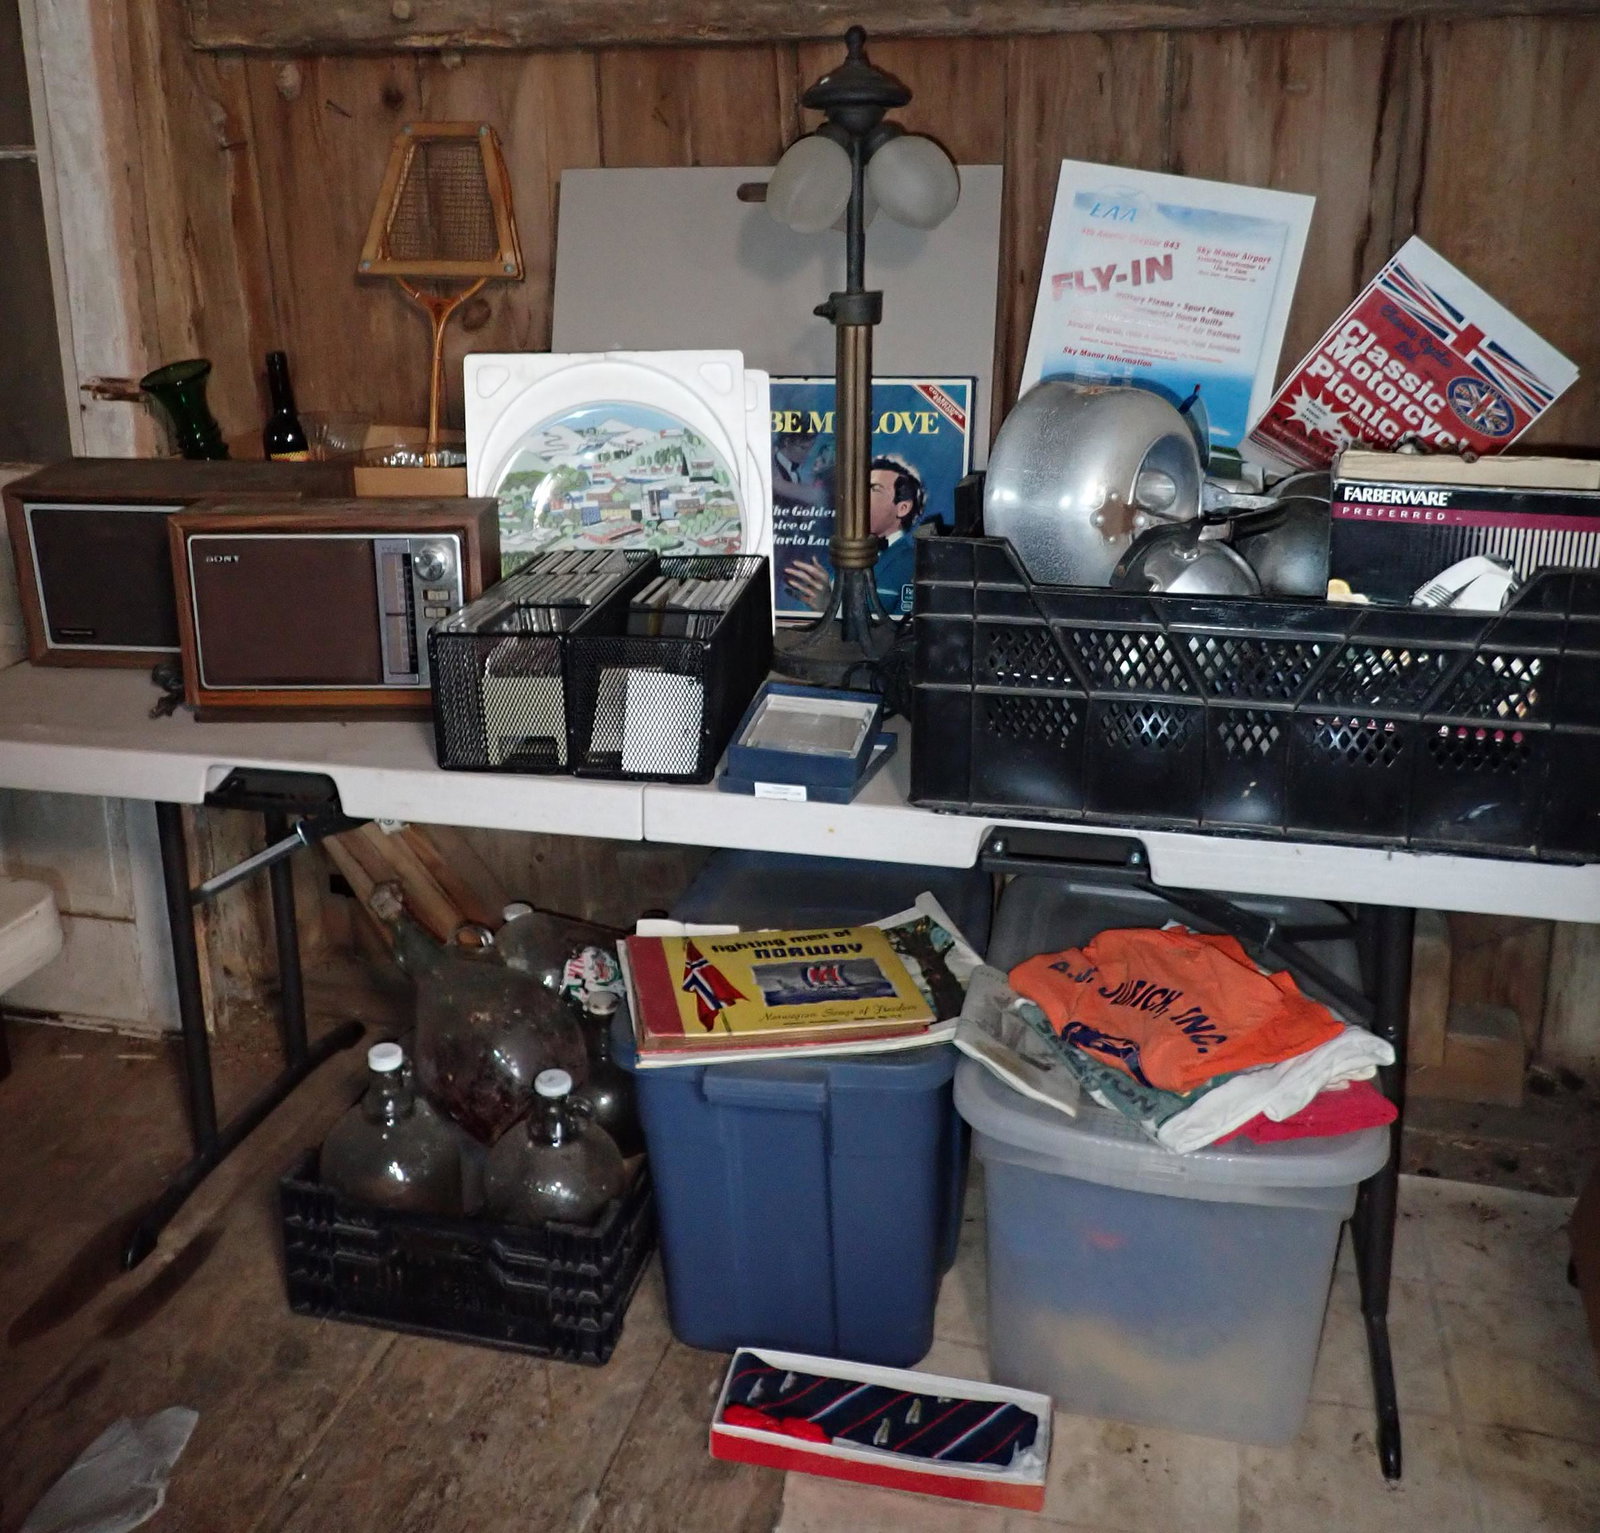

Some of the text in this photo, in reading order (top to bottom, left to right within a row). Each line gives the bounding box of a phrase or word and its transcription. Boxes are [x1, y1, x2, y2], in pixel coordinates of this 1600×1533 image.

[1241, 252, 1272, 264] Airport
[1052, 254, 1174, 302] FLY-IN
[1183, 302, 1206, 313] Sport
[1207, 306, 1235, 318] Planes
[1062, 346, 1079, 357] Sky
[1080, 349, 1105, 361] Manor
[1340, 319, 1446, 414] Classic
[1306, 354, 1400, 440] Picnic
[1324, 333, 1470, 450] Motorcyc
[771, 411, 939, 435] BE M OVE
[1344, 486, 1449, 507] FARBERWARE
[773, 505, 790, 517] he
[1342, 507, 1446, 521] PREFERRED
[799, 519, 816, 531] of
[789, 932, 830, 944] men
[833, 929, 851, 938] of
[759, 1012, 817, 1023] Norwegian
[859, 1005, 869, 1017] of
[1170, 1006, 1227, 1053] INC.
